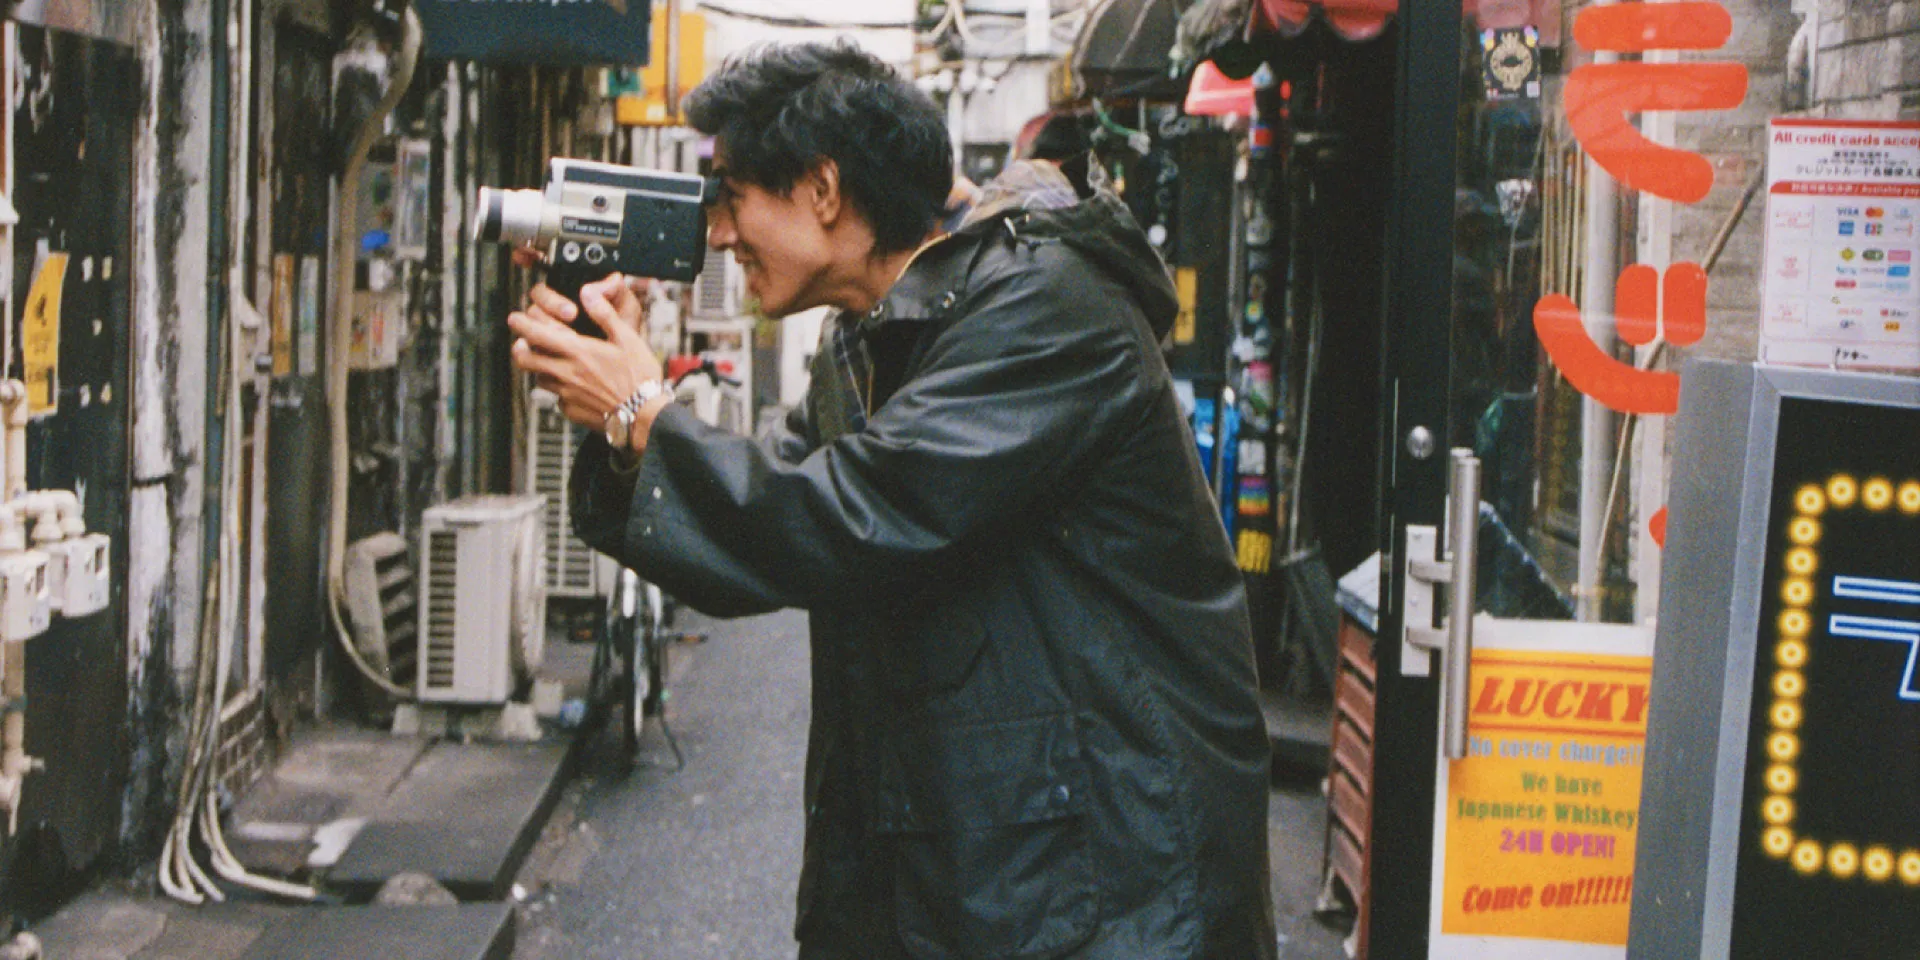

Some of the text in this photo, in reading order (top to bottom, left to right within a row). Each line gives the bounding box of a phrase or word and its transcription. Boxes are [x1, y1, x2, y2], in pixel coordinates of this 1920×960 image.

[1774, 131, 1792, 144] All
[1796, 132, 1836, 146] credit
[1840, 134, 1880, 146] cards
[1472, 676, 1649, 723] LUCKY
[1468, 736, 1493, 758] No
[1499, 738, 1552, 760] cover
[1521, 771, 1603, 795] We have
[1457, 798, 1636, 831] Japanese Whiskey
[1499, 828, 1616, 860] 24H OPEN!
[1462, 883, 1534, 914] Come
